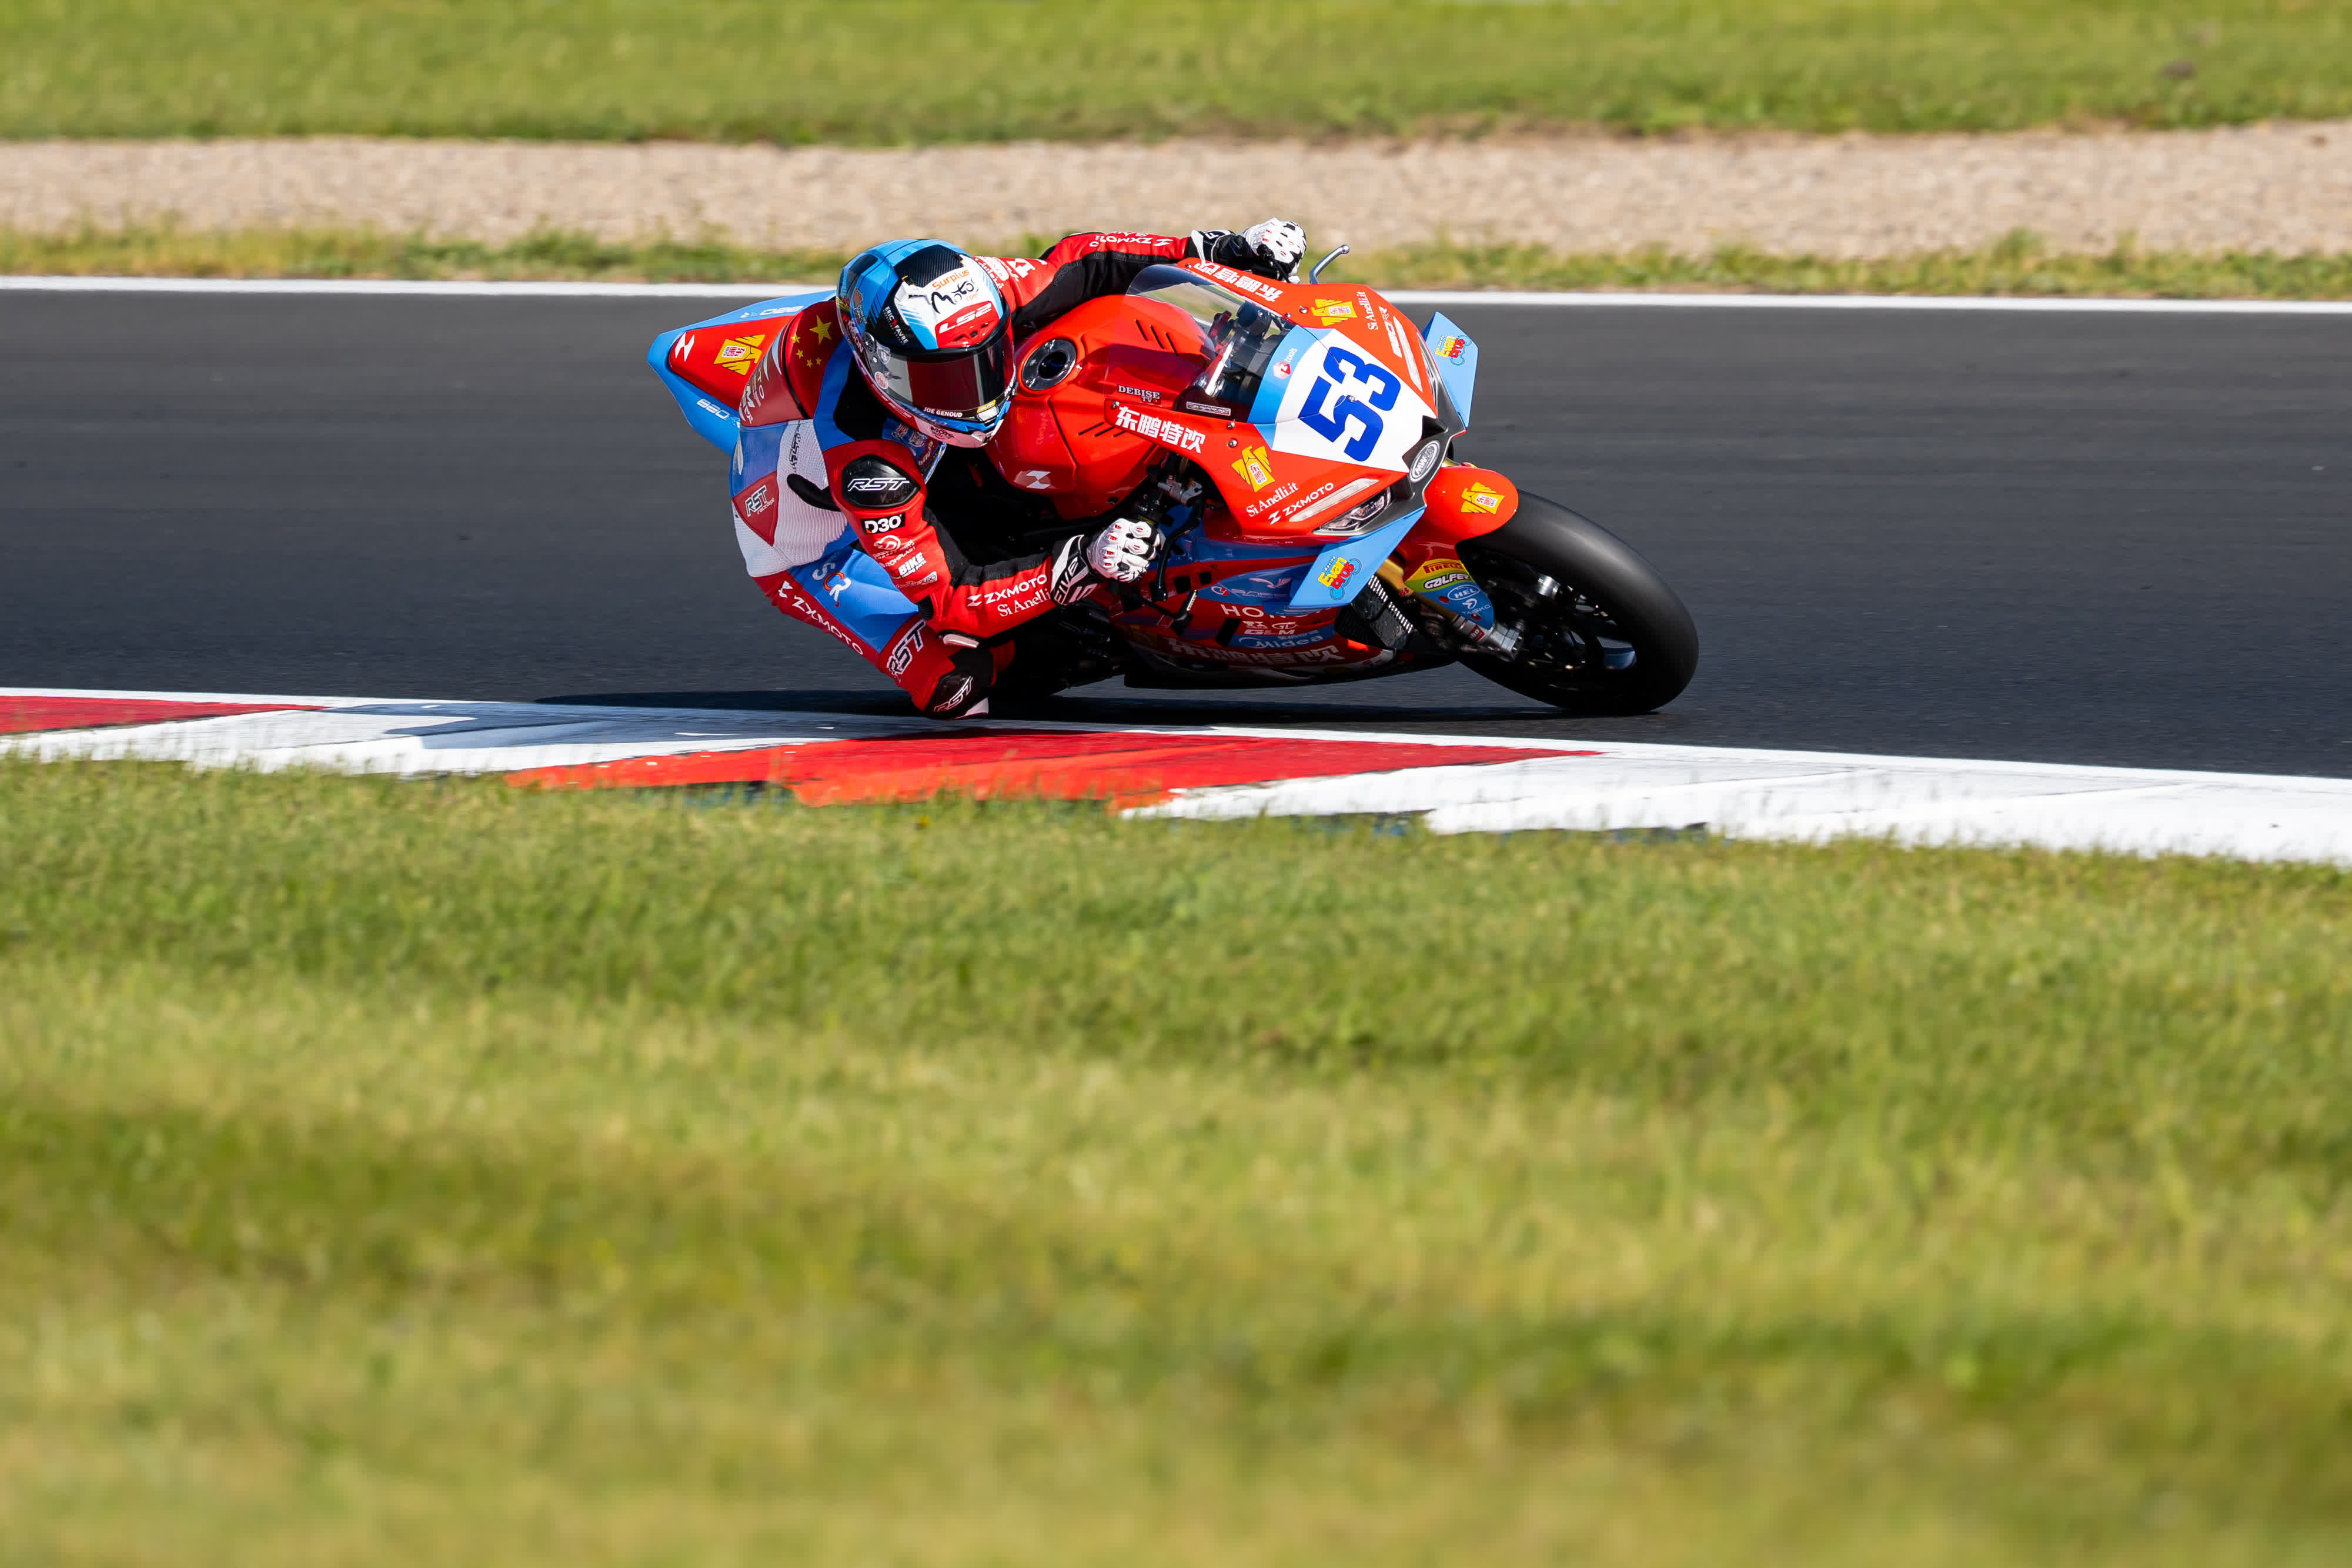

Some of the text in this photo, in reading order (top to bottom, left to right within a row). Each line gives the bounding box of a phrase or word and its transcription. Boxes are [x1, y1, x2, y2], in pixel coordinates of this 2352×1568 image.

[932, 269, 970, 290] Surplus
[885, 306, 894, 321] ERIC
[894, 325, 908, 344] FAVRE
[939, 302, 992, 334] LS2
[1118, 385, 1160, 399] DEBISE
[1298, 346, 1401, 462] 53
[936, 410, 963, 418] GENOUD
[1115, 406, 1206, 454] 东鹏特饮
[847, 477, 910, 492] RST
[1246, 482, 1299, 517] Si Anelli.it
[1282, 482, 1334, 517] ZXMOTO
[744, 484, 767, 517] RST
[898, 551, 924, 576] BIKE
[1317, 557, 1348, 587] Evan
[984, 574, 1048, 604] ZXMOTO
[997, 588, 1051, 617] Si Anelli
[1454, 587, 1477, 599] HEL
[791, 594, 864, 656] ZXMOTO
[886, 618, 927, 675] RST
[1252, 635, 1324, 649] Midea
[933, 676, 974, 713] RST
